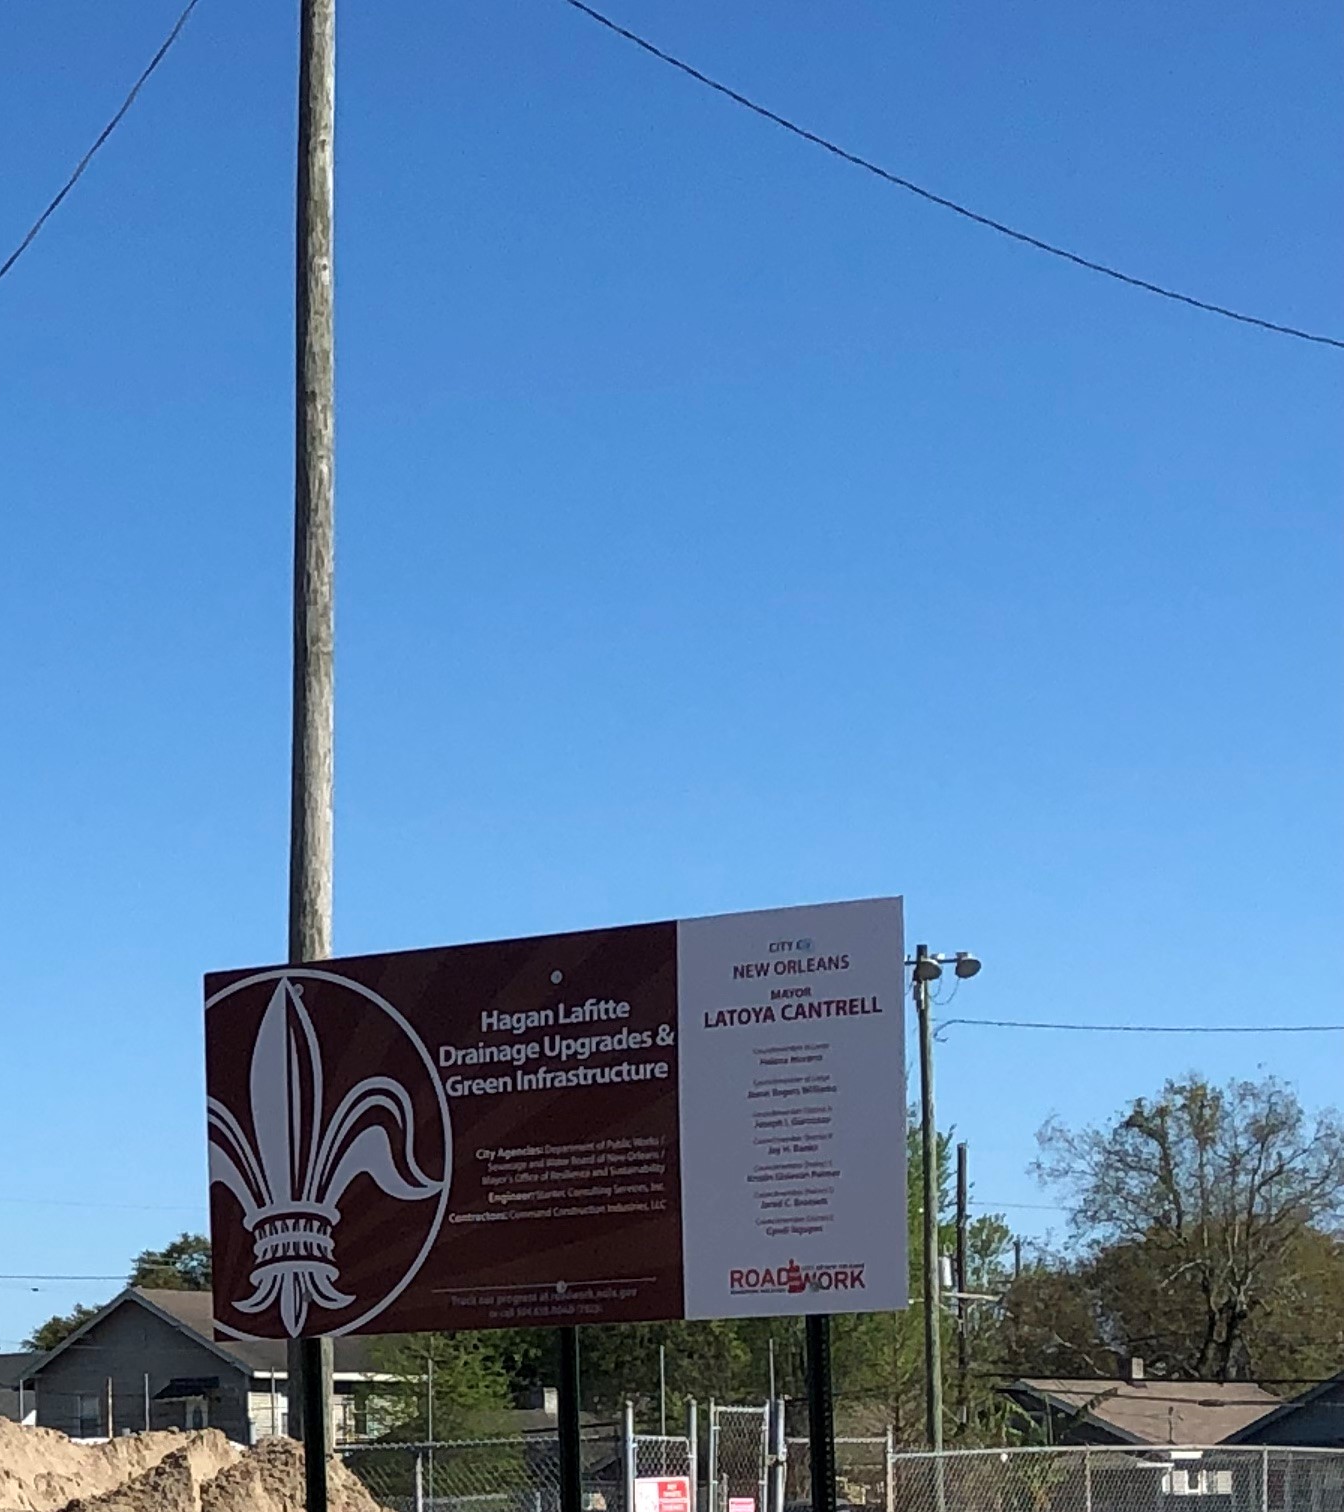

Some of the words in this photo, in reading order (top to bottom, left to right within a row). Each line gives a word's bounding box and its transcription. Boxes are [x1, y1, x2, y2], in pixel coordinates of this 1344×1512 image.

[769, 941, 793, 953] CITY
[733, 963, 770, 979] NEW
[774, 954, 850, 976] ORLEANS
[771, 987, 811, 1000] MAYOR
[481, 1009, 553, 1033] Hagan
[559, 998, 630, 1024] Lafitte
[704, 1006, 775, 1028] LATOYA
[781, 996, 882, 1021] CANTRELL
[439, 1042, 539, 1067] Drainage
[544, 1027, 651, 1061] Upgrades
[656, 1024, 674, 1046] &
[446, 1076, 512, 1097] Green
[517, 1061, 668, 1091] Infrastructure
[476, 1148, 496, 1160] City
